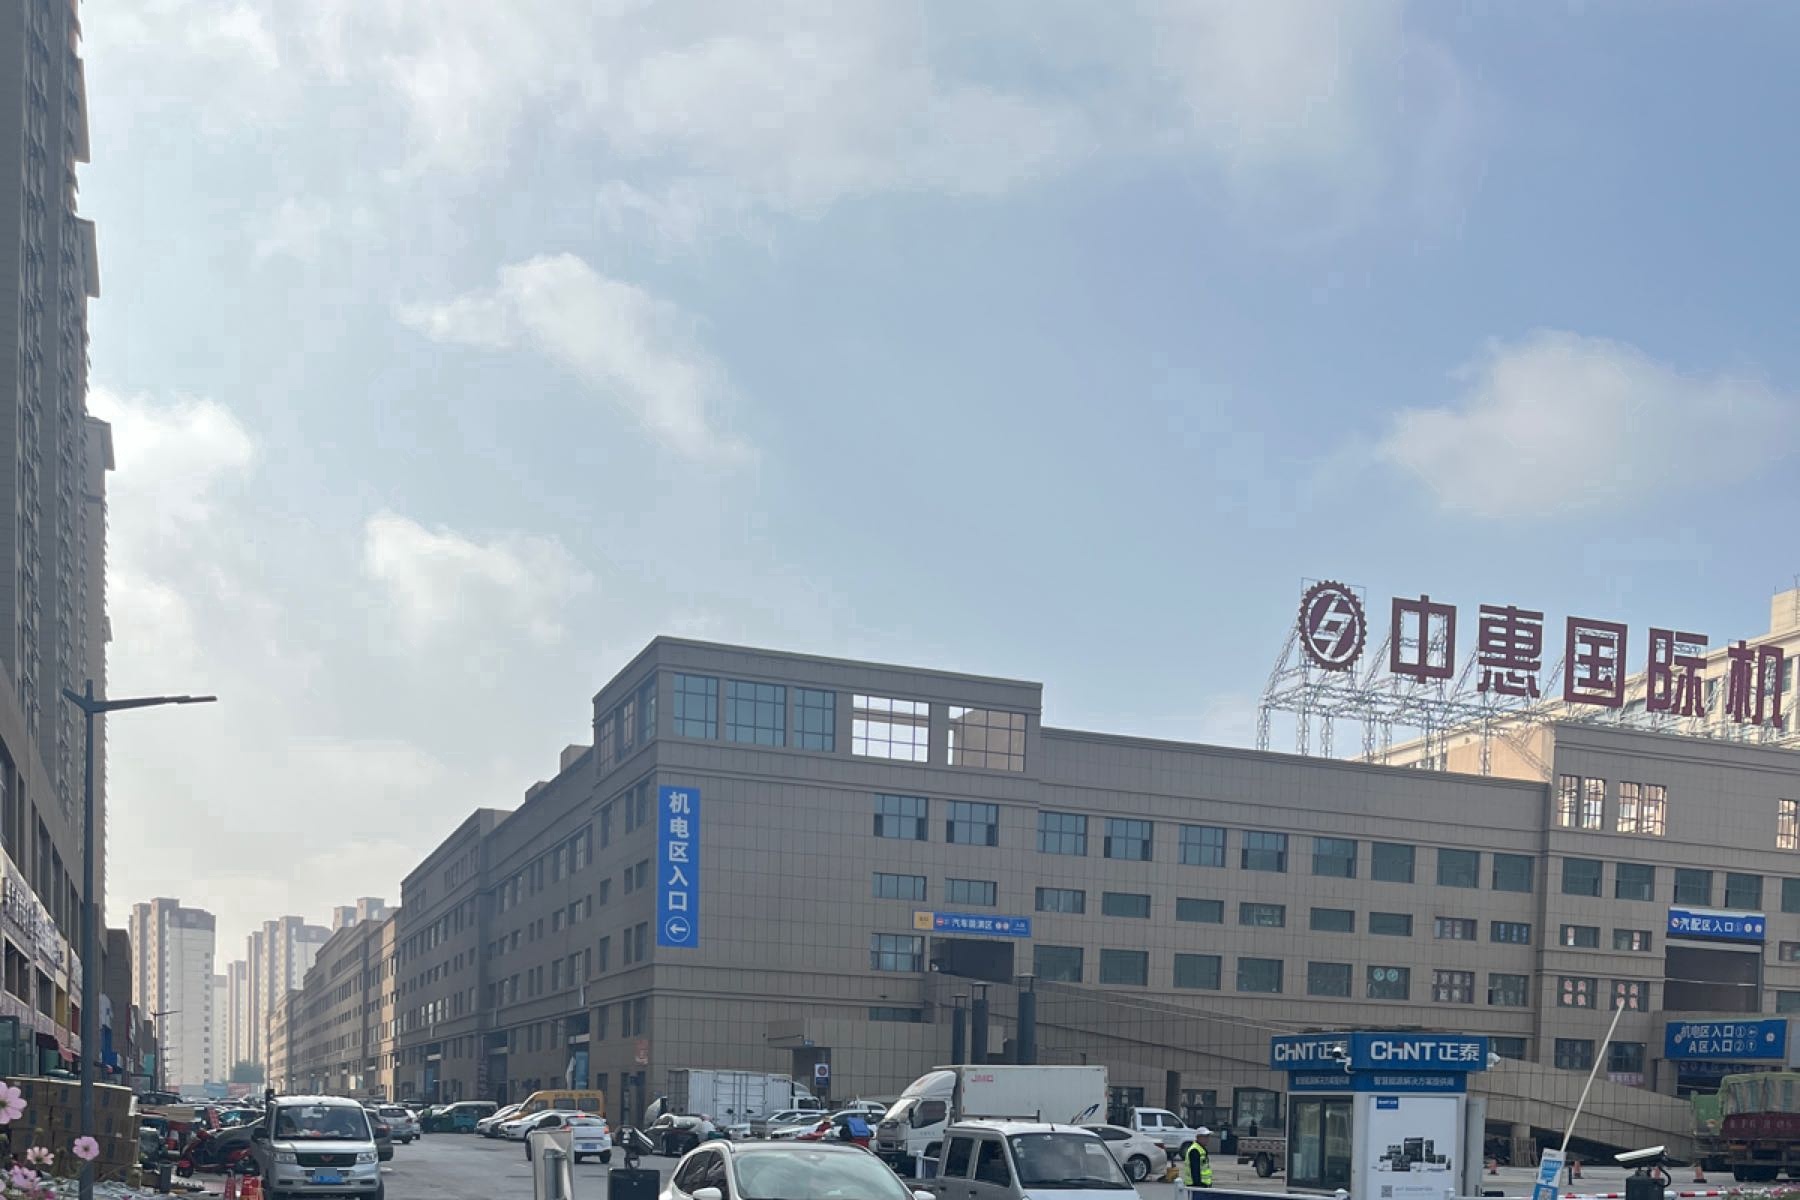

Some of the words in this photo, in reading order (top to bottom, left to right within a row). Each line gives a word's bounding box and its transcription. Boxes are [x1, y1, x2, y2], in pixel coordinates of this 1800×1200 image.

[1390, 594, 1784, 728] 中惠国际机
[668, 791, 690, 912] 机电区入口
[1438, 1043, 1479, 1061] 正泰
